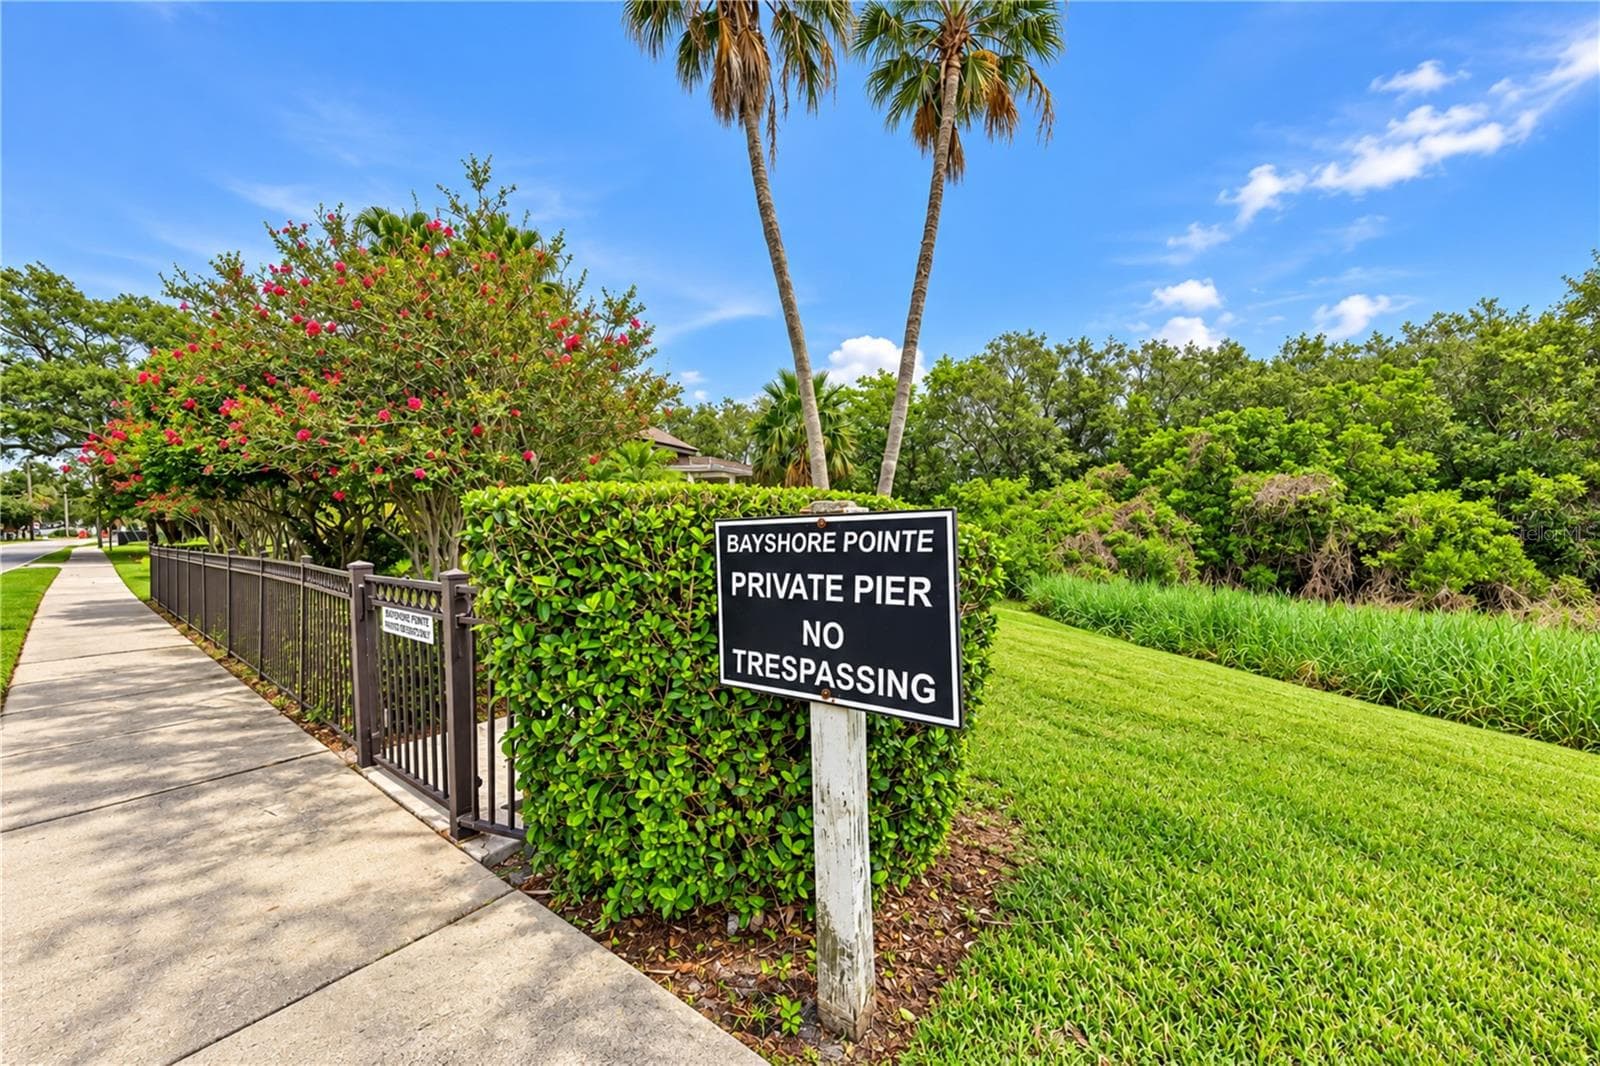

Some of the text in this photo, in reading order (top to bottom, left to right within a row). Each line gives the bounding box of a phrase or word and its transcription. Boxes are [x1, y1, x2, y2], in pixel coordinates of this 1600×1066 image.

[726, 529, 935, 554] BAYSHORE POINTE
[731, 571, 934, 608] PRIVATE PIER
[802, 619, 845, 650] NO
[732, 648, 937, 704] TRESPASSING
